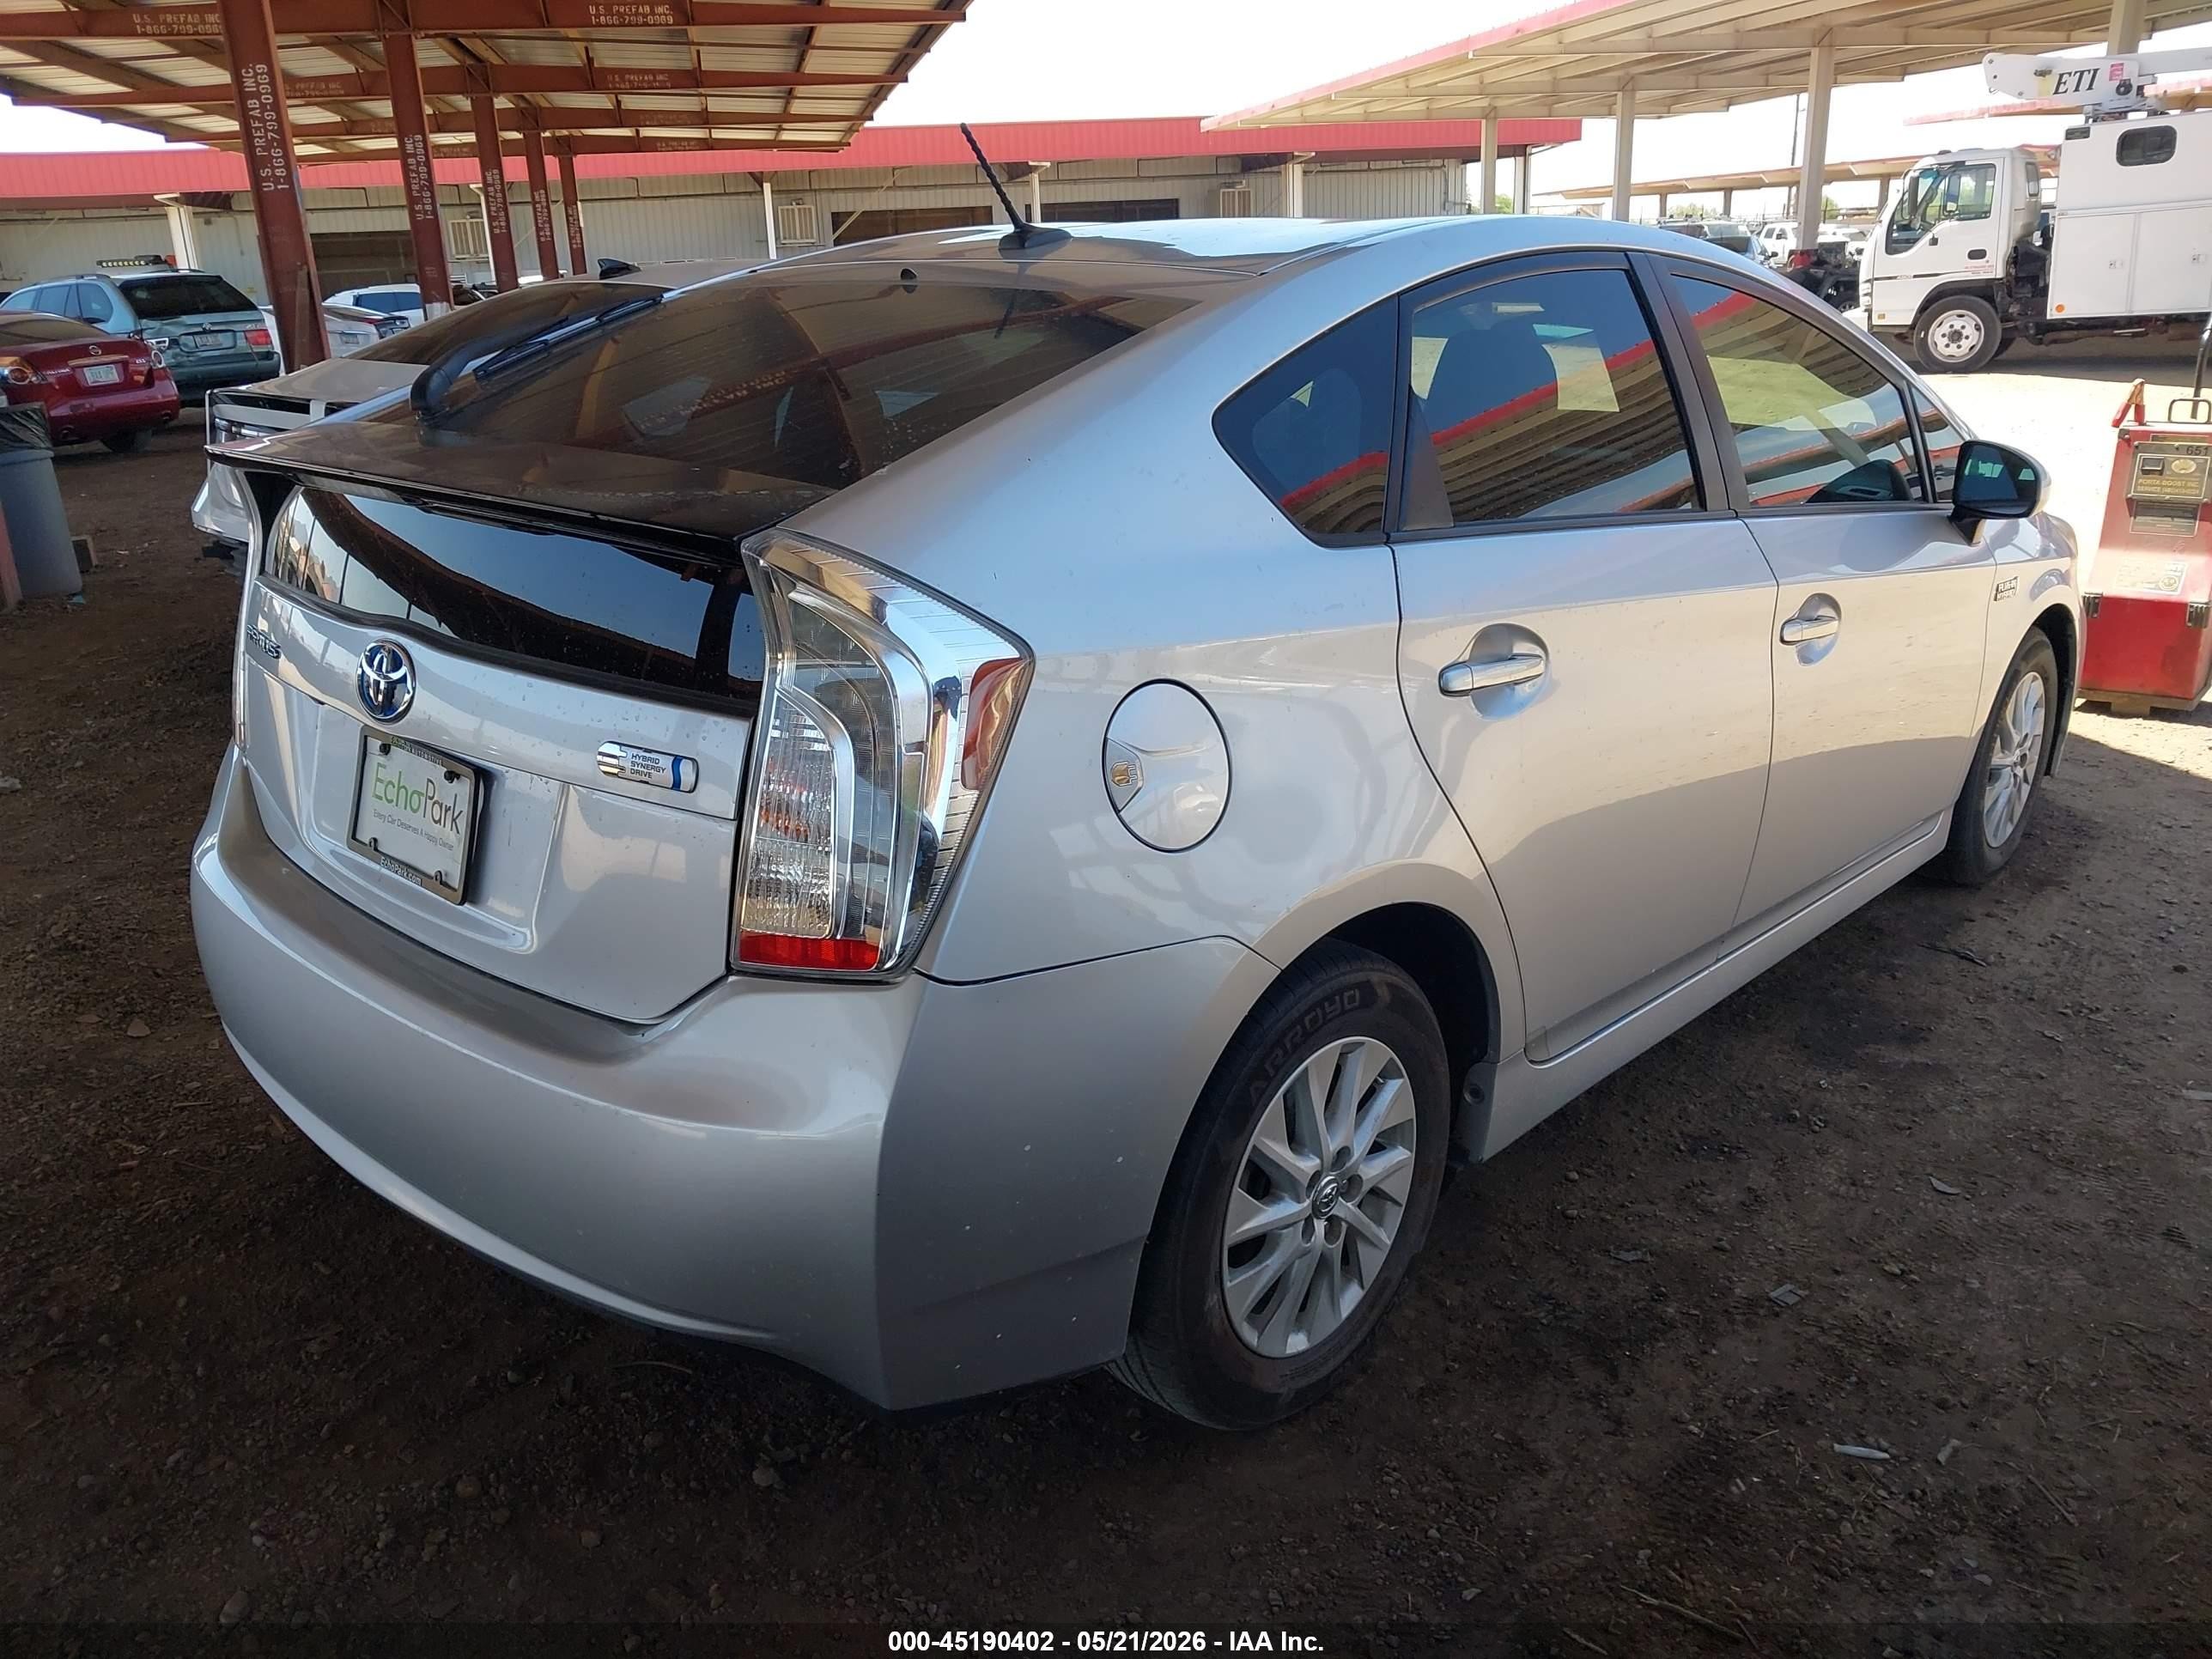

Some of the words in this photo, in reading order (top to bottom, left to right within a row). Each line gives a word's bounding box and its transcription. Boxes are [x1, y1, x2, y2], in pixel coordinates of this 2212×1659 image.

[158, 14, 200, 23] PREFAB
[589, 5, 608, 15] U.S.
[612, 5, 650, 15] PREFAB
[654, 5, 673, 15] INC.
[241, 63, 257, 91] INC.
[2052, 68, 2100, 95] ETI
[247, 99, 268, 155] PREFAB
[255, 64, 289, 190] 1-866-799-0969
[260, 163, 275, 191] U.S.
[407, 158, 421, 197] PREFAB
[2186, 446, 2209, 456] 651
[630, 760, 666, 774] SYNERGY
[631, 752, 660, 764] HYBRID
[629, 768, 653, 779] DRIVE
[372, 762, 464, 835] EchoPark
[387, 814, 397, 825] Car
[397, 818, 420, 836] Deserves
[380, 857, 422, 887] EchoPark.com
